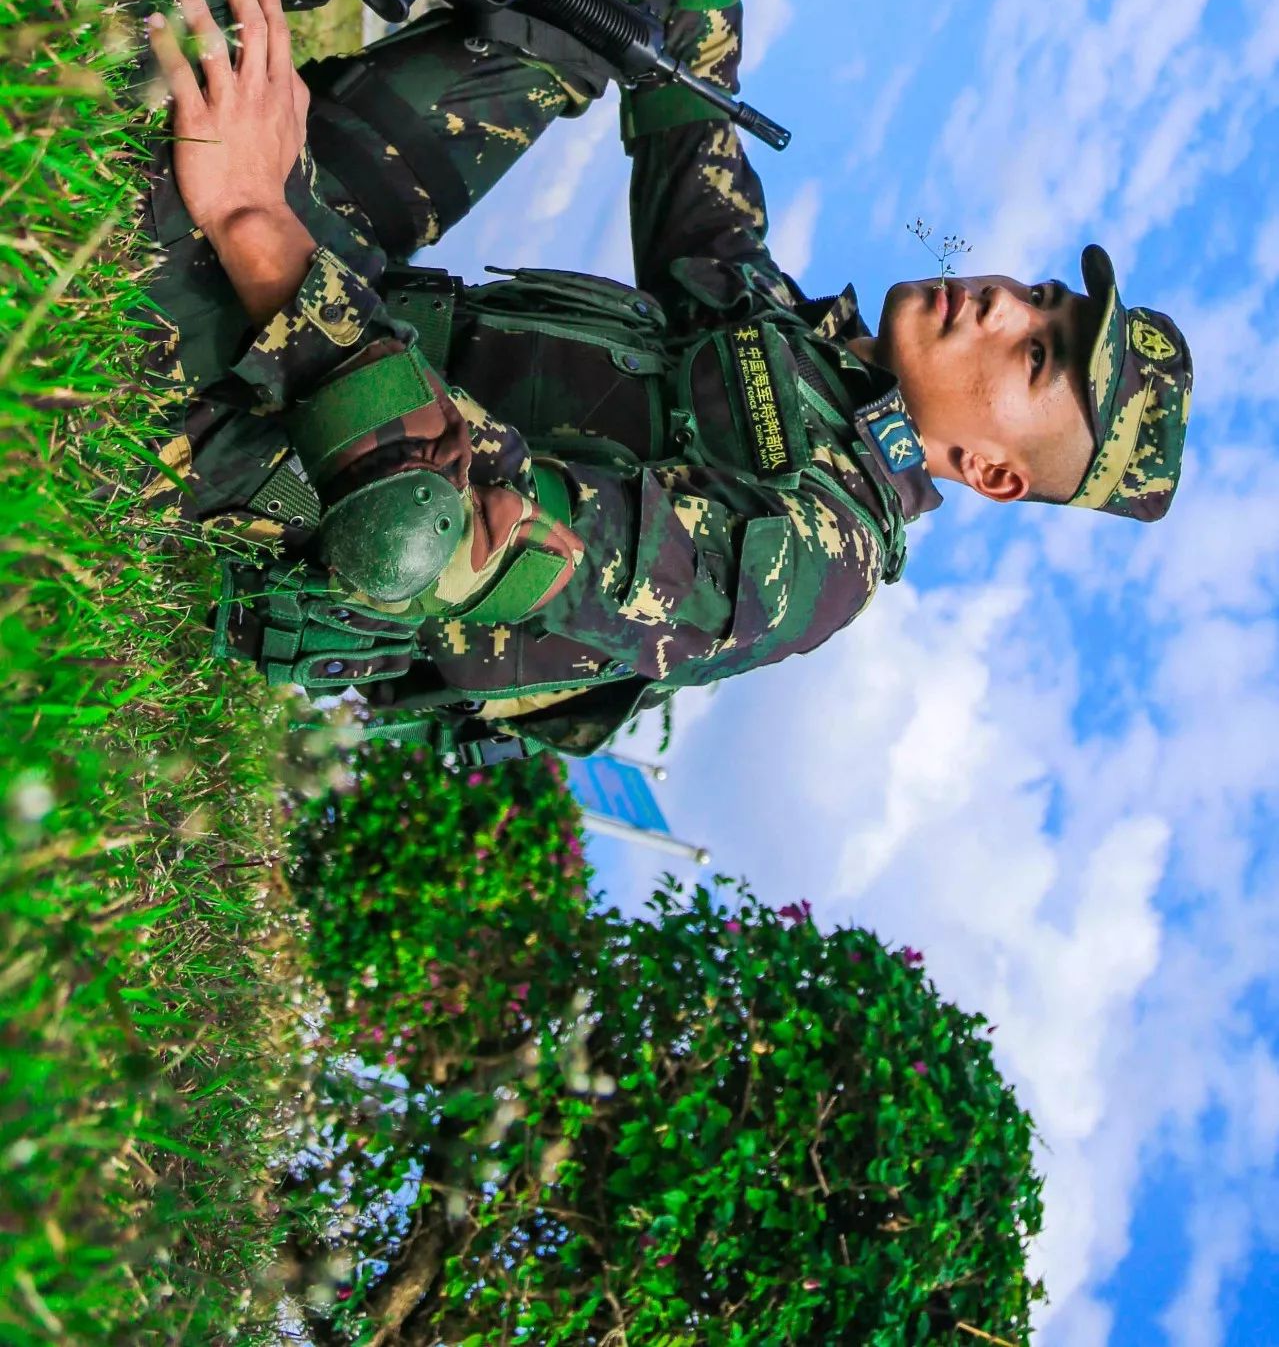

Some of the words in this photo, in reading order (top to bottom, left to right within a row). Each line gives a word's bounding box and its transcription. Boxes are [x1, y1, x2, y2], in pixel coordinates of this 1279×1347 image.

[737, 347, 746, 358] THE
[740, 359, 751, 384] SPECIAL
[746, 386, 757, 410] FORCE
[746, 347, 787, 469] 中国海军特种部队
[752, 412, 760, 421] OF
[755, 424, 765, 447] CHINA
[760, 448, 770, 469] NAVY
